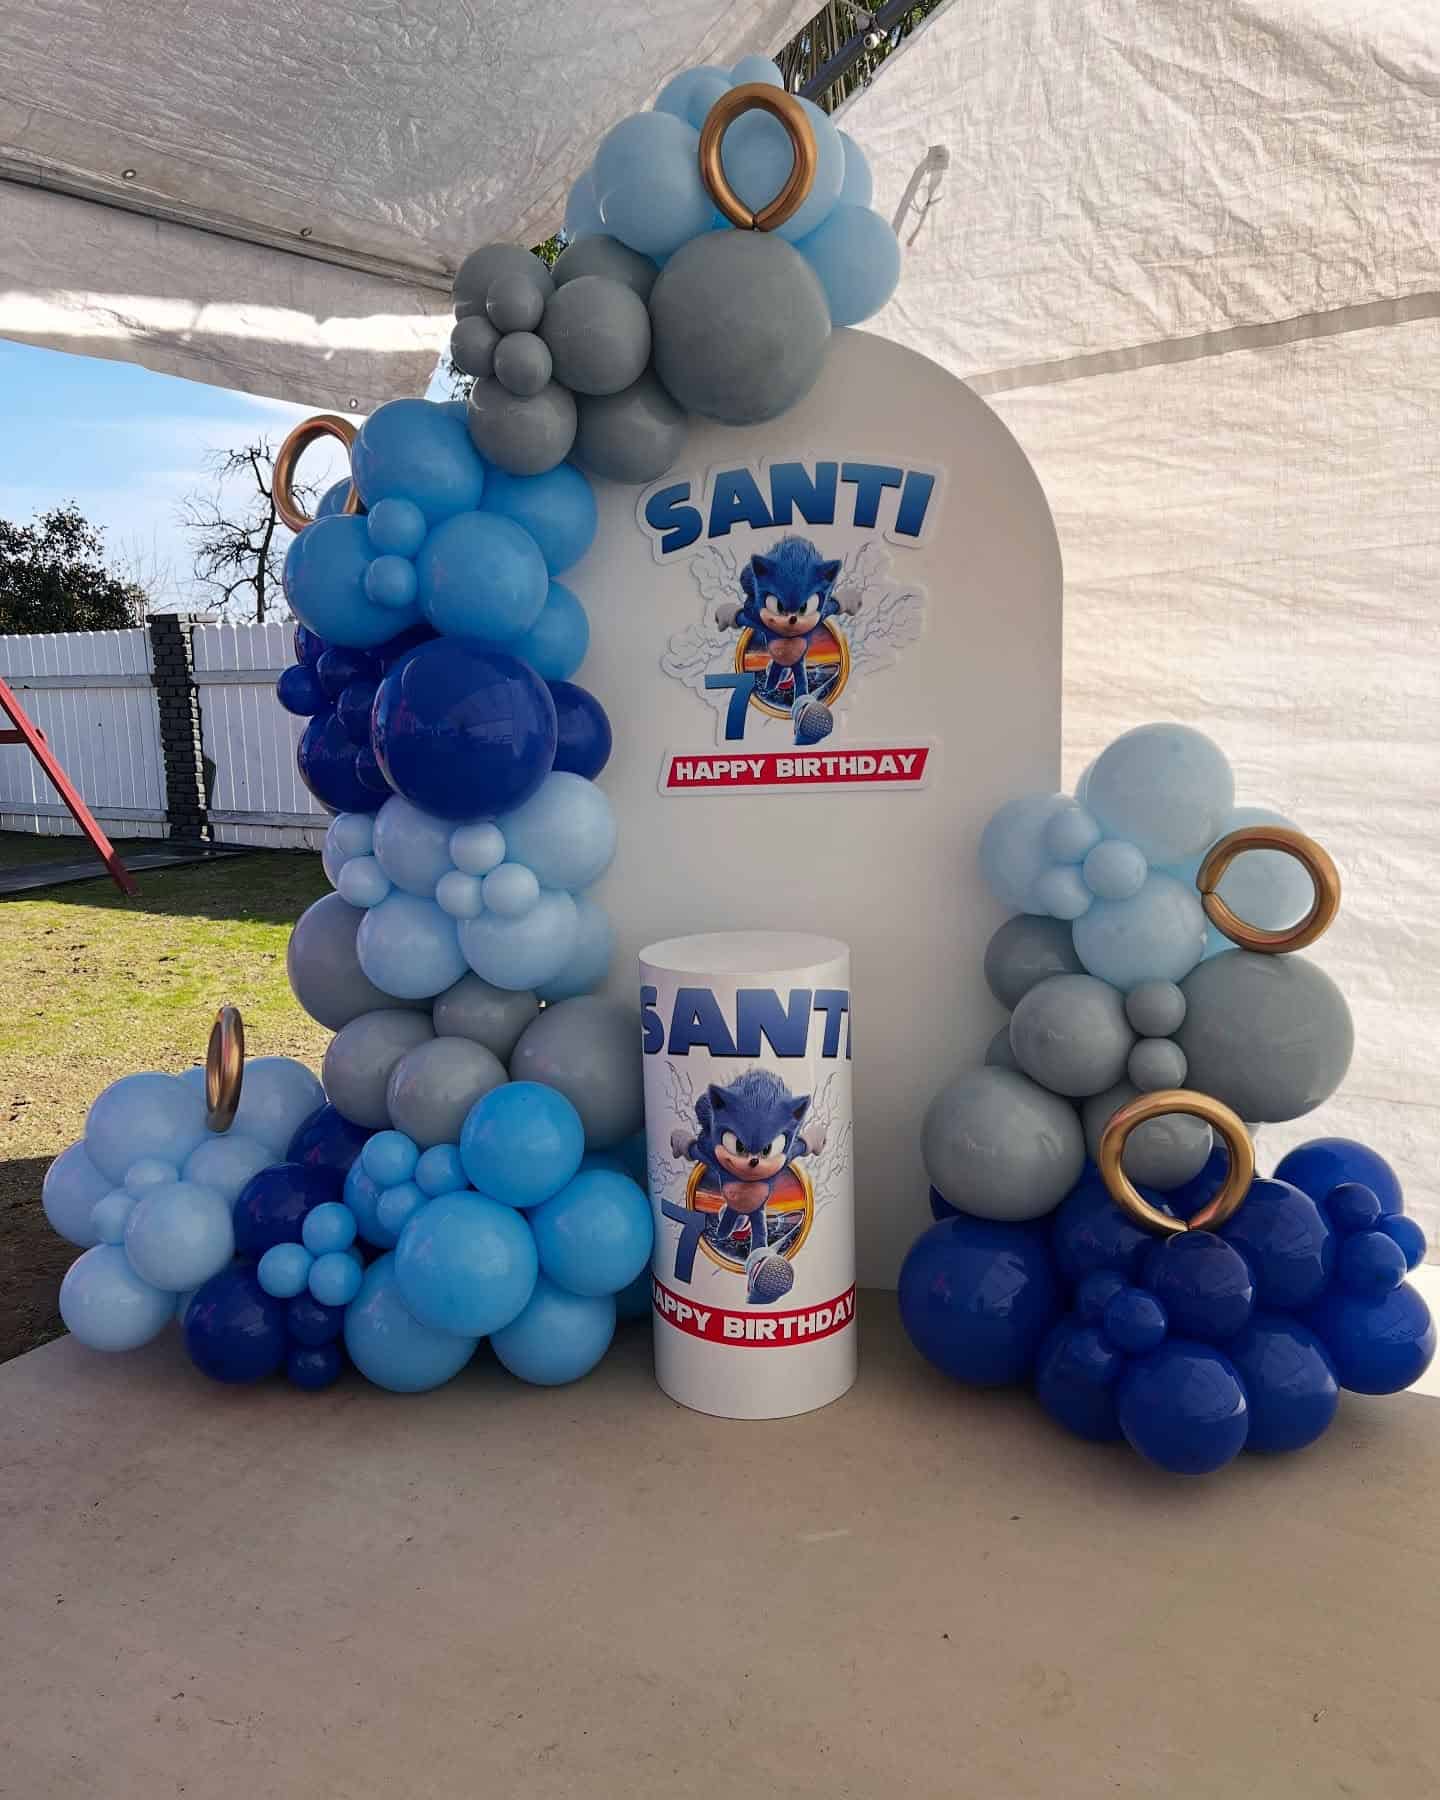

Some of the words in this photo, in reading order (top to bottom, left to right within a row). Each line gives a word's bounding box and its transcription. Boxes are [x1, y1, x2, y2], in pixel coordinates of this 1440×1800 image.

[645, 462, 935, 554] SANTI
[704, 672, 754, 741] 7
[676, 760, 766, 781] HAPPY
[776, 754, 917, 778] BIRTHDAY
[640, 985, 852, 1060] SANT
[662, 1198, 706, 1285] 7
[723, 1290, 855, 1340] BIRTHDAY
